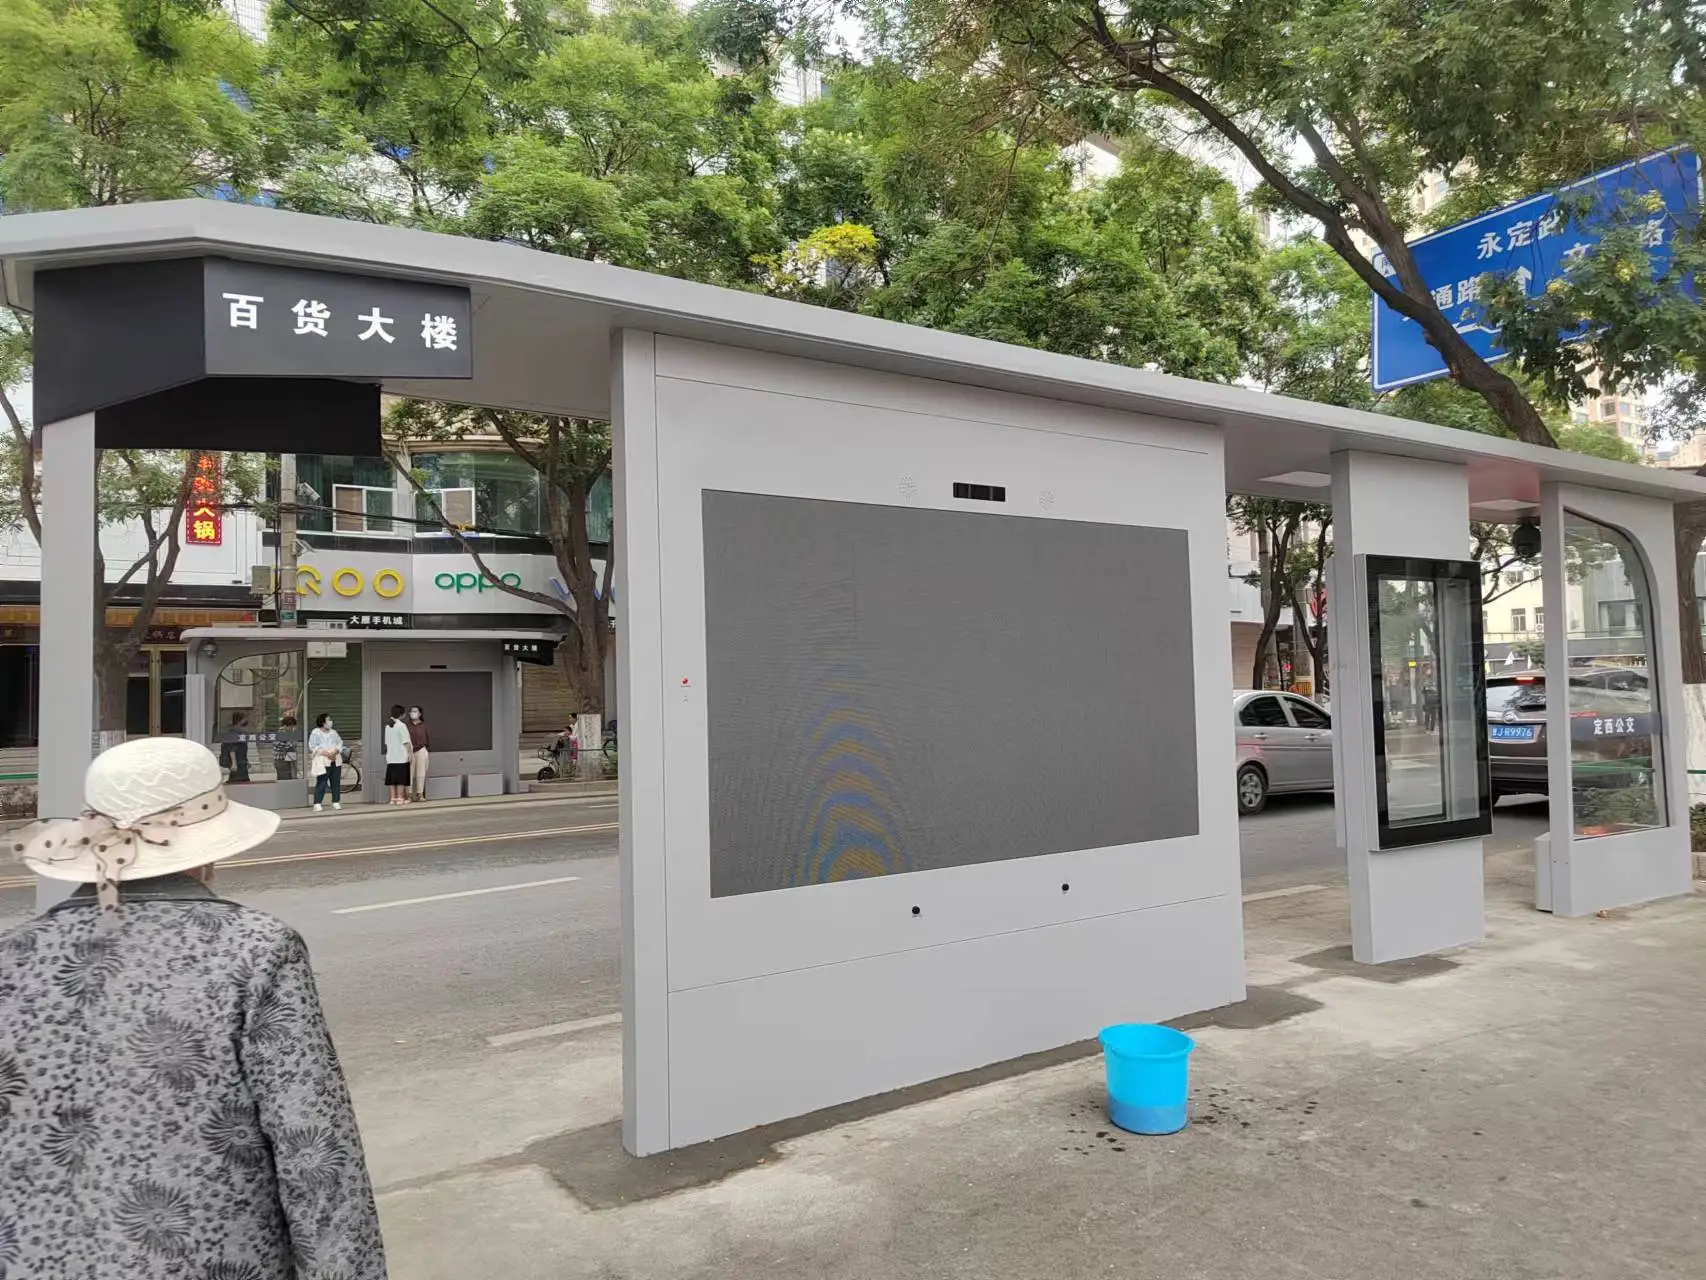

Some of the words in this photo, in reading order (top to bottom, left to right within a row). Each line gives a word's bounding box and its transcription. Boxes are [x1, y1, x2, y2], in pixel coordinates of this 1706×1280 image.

[222, 292, 457, 351] 百货大楼
[1593, 717, 1635, 735] 定西公交
